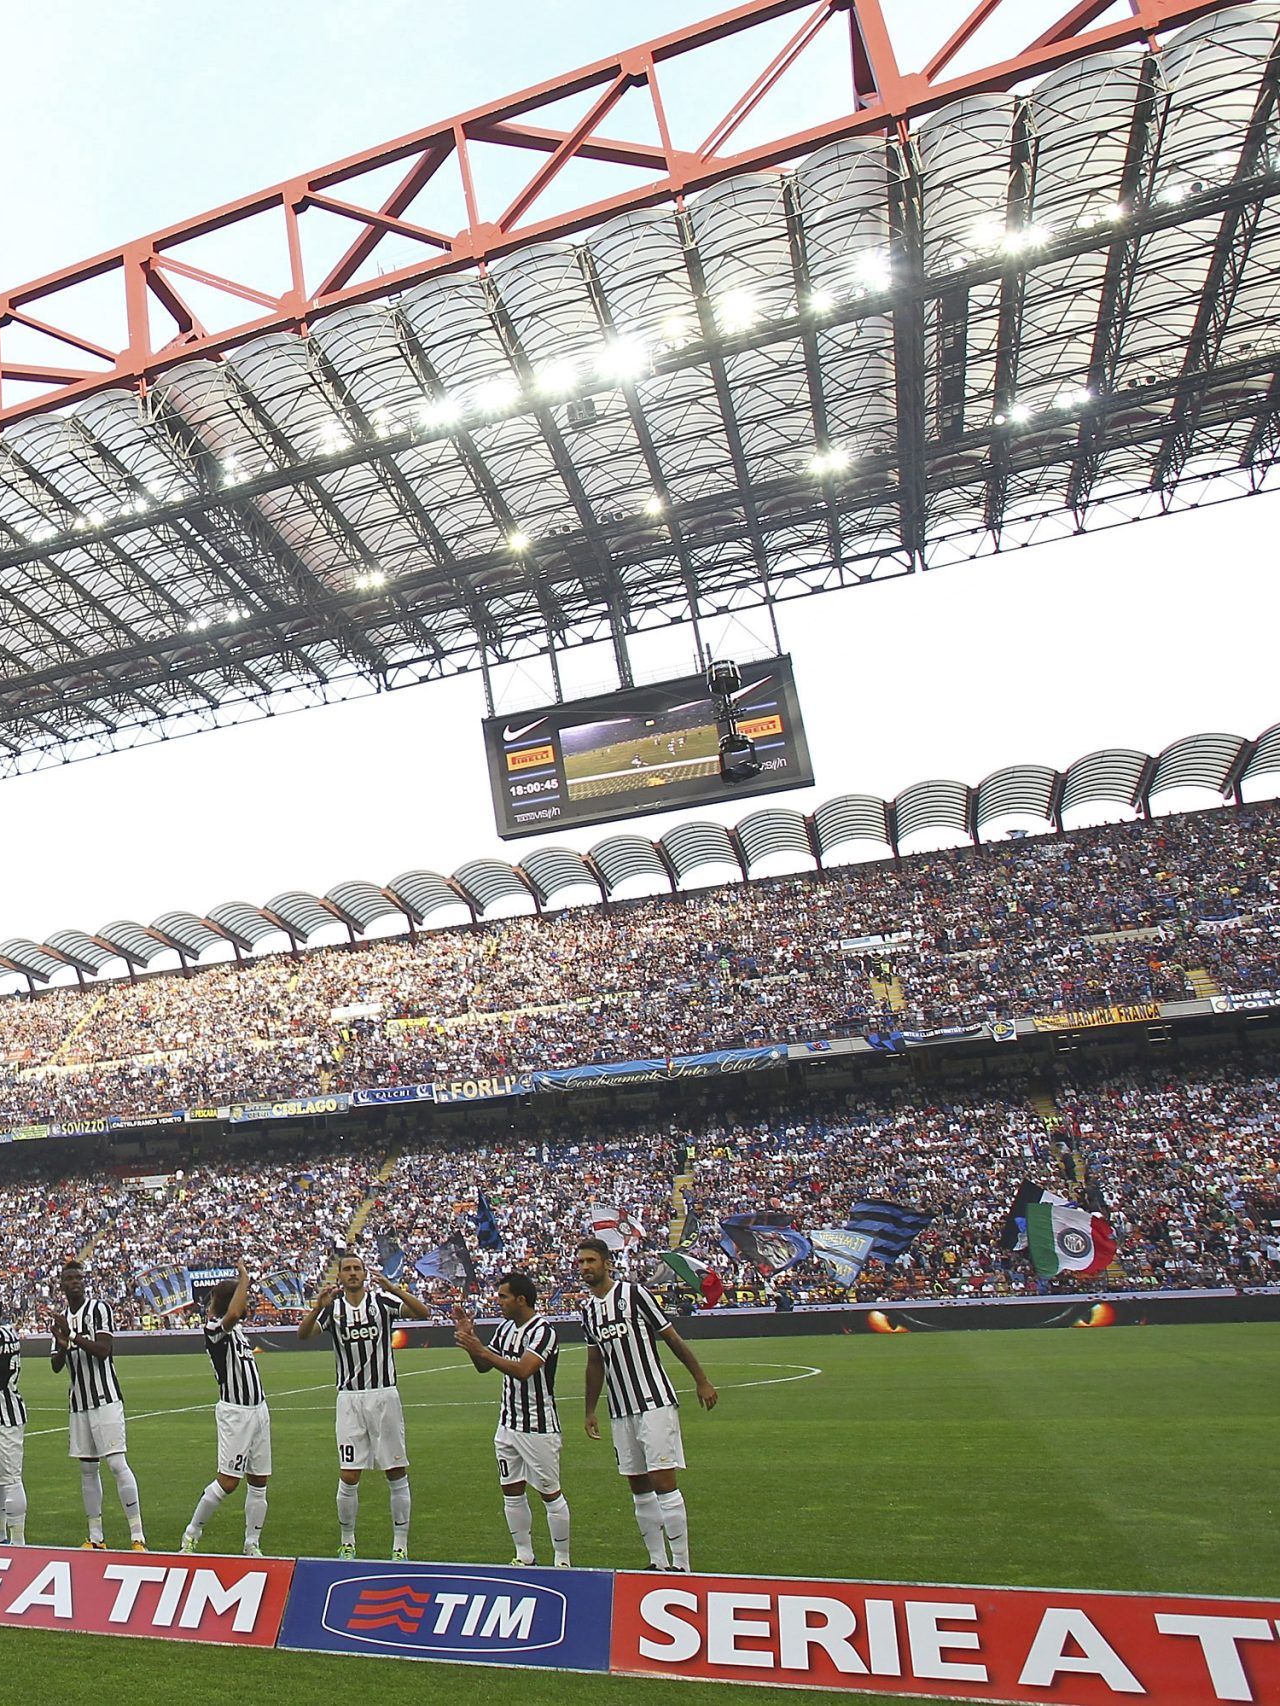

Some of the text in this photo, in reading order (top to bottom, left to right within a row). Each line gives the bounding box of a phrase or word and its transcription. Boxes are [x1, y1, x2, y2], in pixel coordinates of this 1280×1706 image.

[511, 751, 549, 765] PIRELLI
[510, 779, 559, 796] 18:00:45
[1231, 990, 1270, 1001] INTER
[1067, 1008, 1115, 1027] MARTINA
[1118, 1003, 1161, 1022] FRANCA
[716, 1052, 758, 1073] Club
[272, 1098, 337, 1118] CISLAGO
[61, 1120, 105, 1135] SOVIZZO
[342, 1325, 379, 1342] Jeep
[595, 1321, 628, 1343] Jeep
[339, 1445, 354, 1463] 19
[5, 1560, 73, 1619] A
[103, 1563, 268, 1633] TIM
[433, 1592, 537, 1640] TIM
[639, 1588, 1280, 1702] SERIE A T
